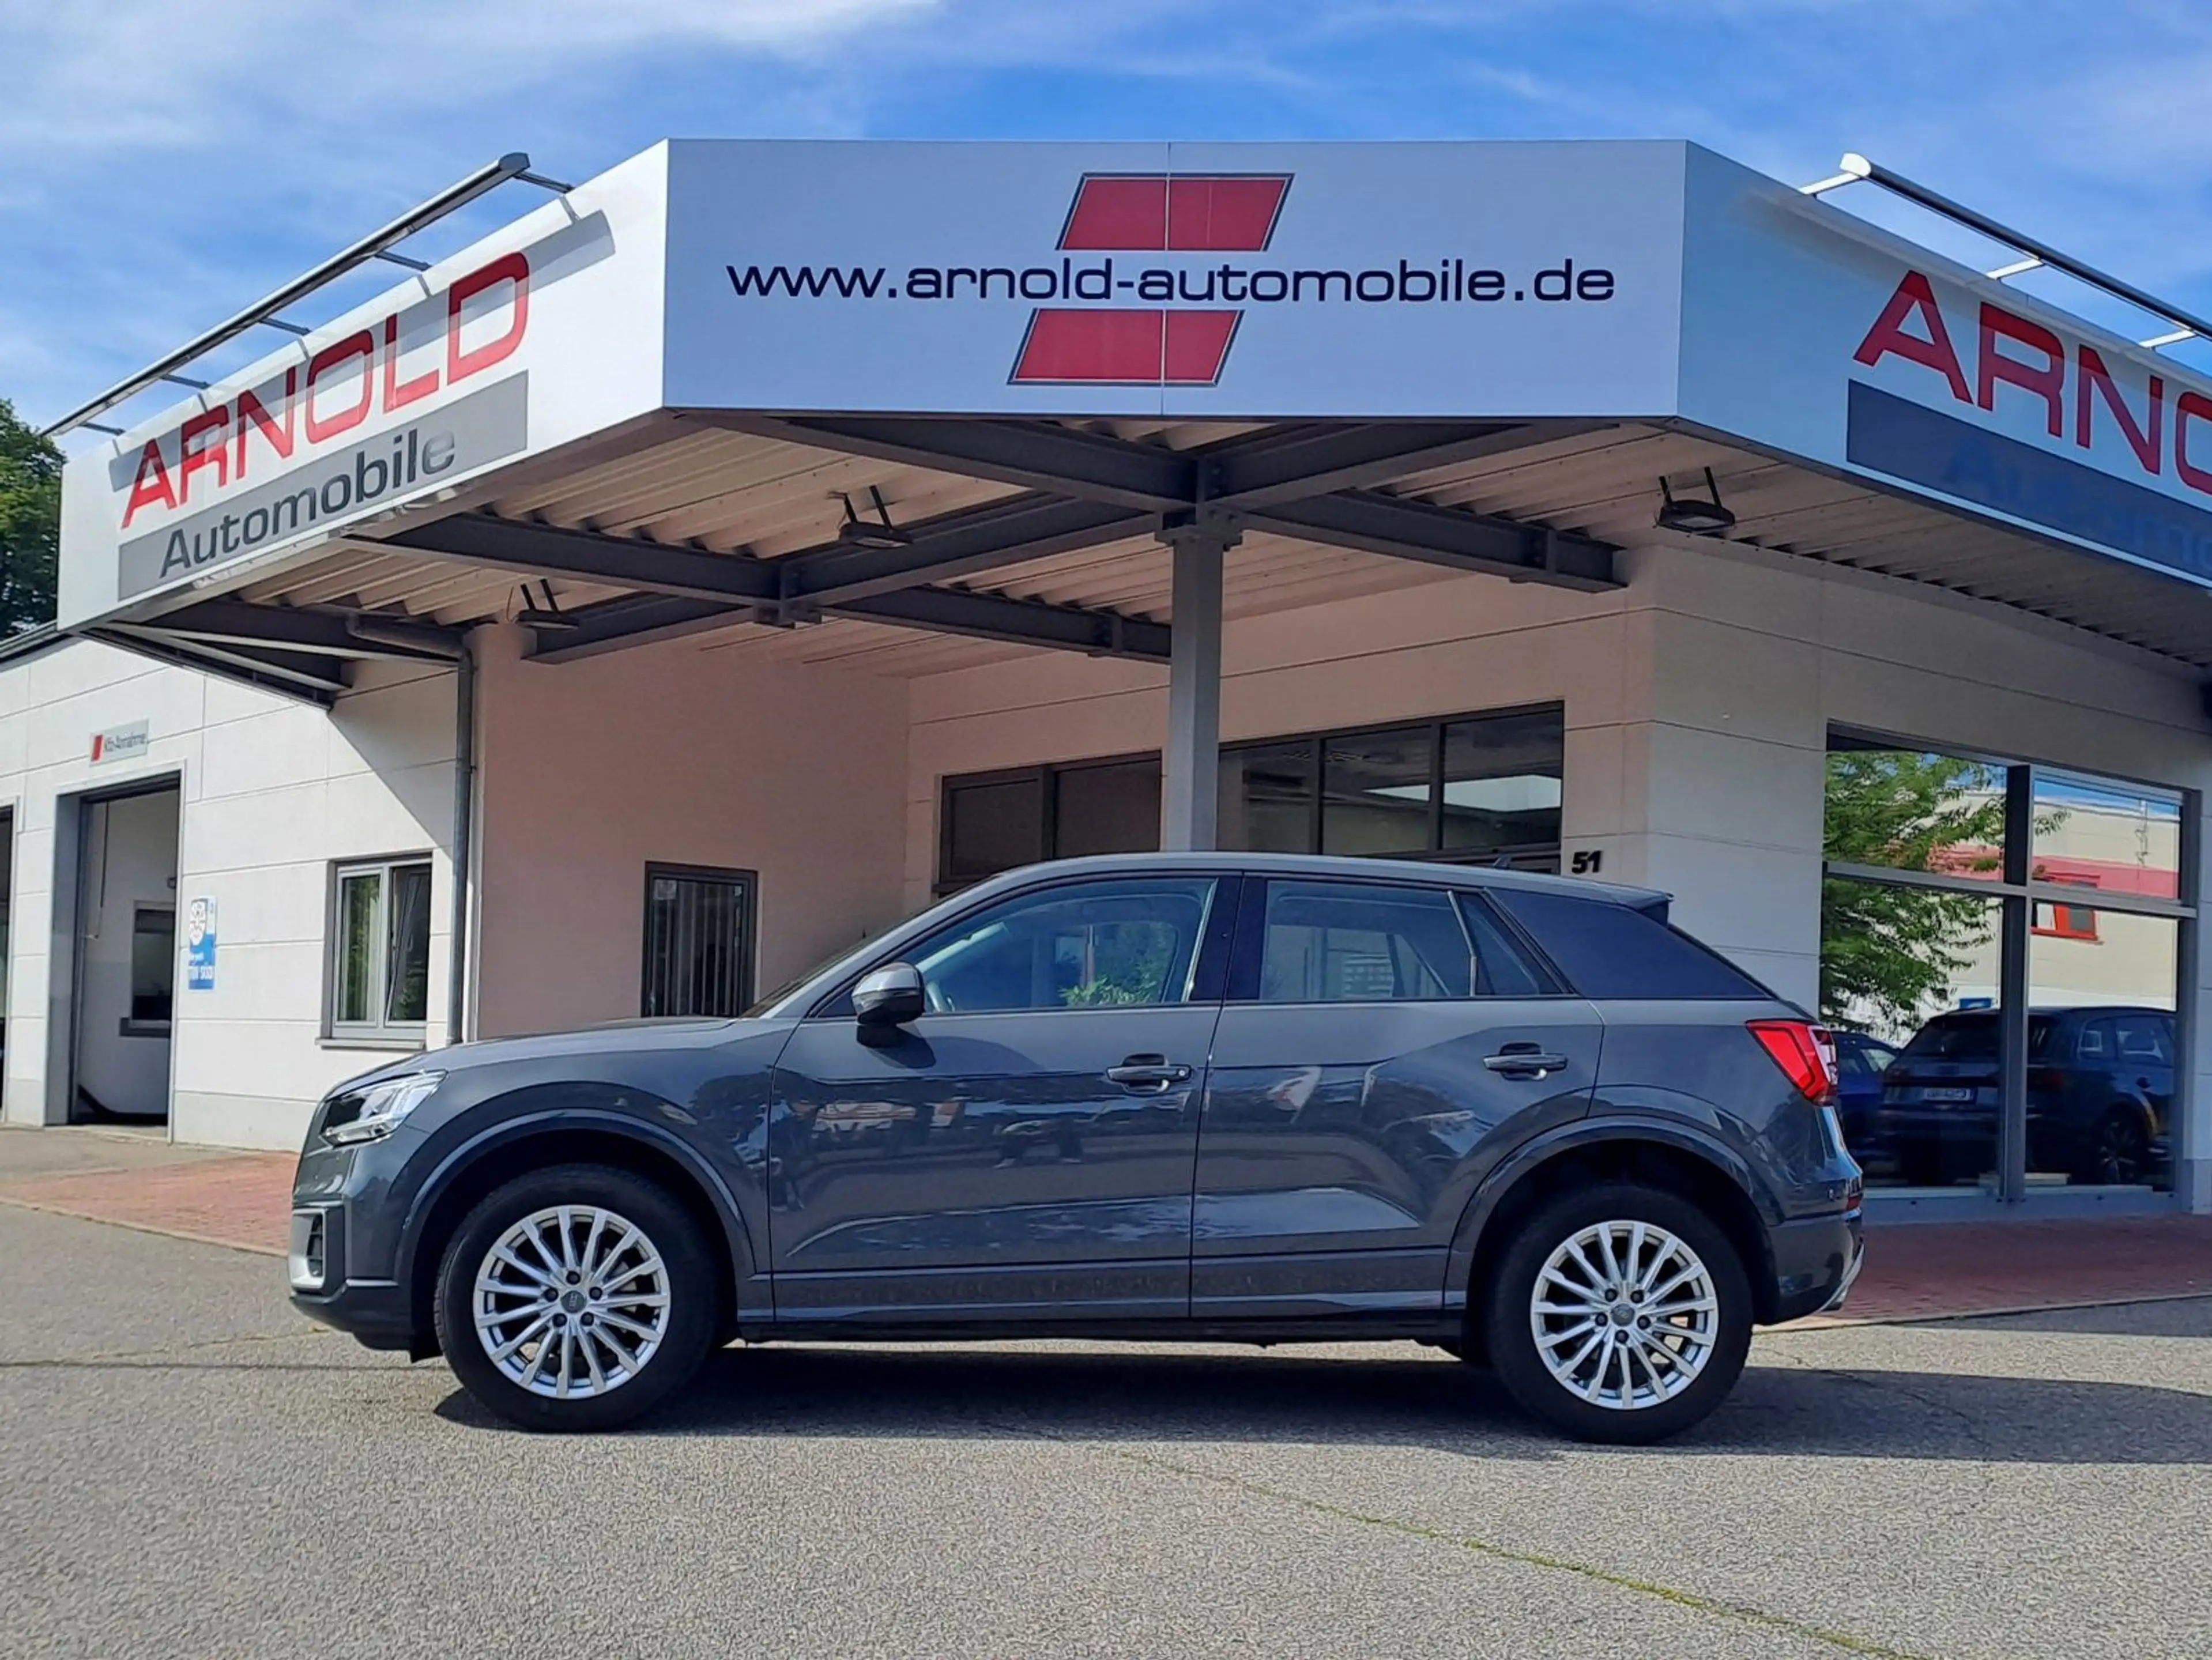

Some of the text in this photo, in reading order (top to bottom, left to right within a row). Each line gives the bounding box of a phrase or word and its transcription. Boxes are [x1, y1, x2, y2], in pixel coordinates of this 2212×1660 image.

[726, 257, 1615, 302] www.arnold-automobile.de
[122, 252, 529, 530] ARNOLD
[159, 428, 455, 579] Automobile
[1571, 850, 1602, 875] 51
